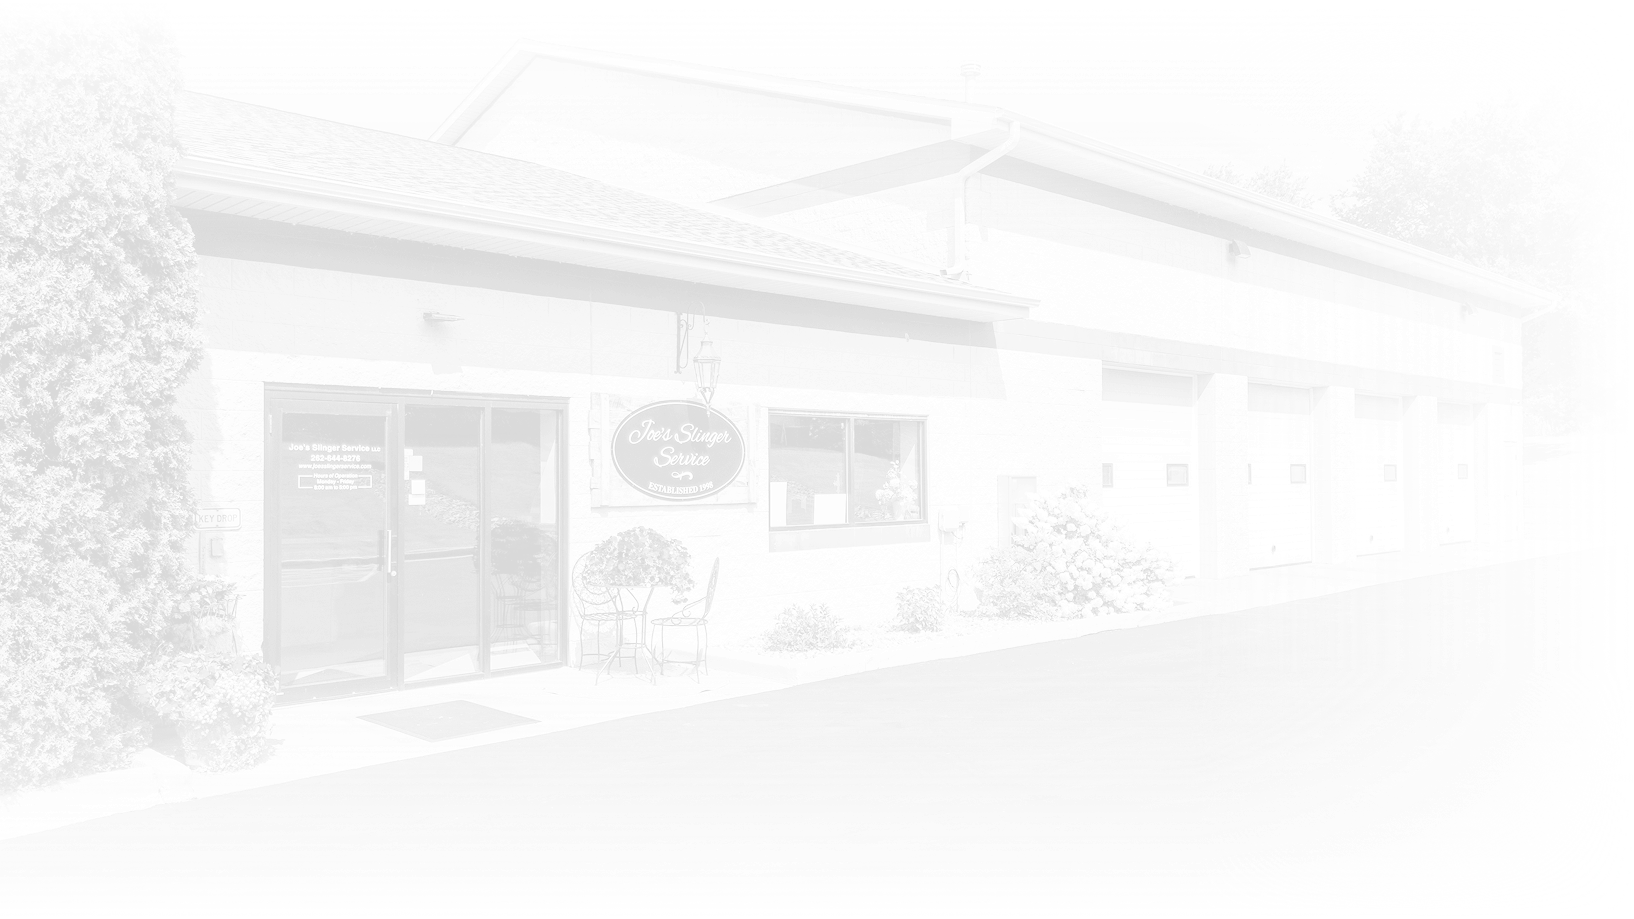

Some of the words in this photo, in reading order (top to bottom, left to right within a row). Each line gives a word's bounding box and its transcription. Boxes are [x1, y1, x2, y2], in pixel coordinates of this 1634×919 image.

[628, 419, 673, 444] Joe's
[674, 422, 732, 448] Slinger
[288, 443, 310, 451] Joe's
[312, 443, 340, 453] Slinger
[341, 444, 370, 452] Service
[310, 454, 361, 462] 262-644-8276
[653, 446, 710, 467] Service
[648, 482, 699, 494] ESTABLISHED
[699, 480, 714, 492] 1998
[199, 514, 215, 523] KEY
[216, 514, 238, 523] DROP
